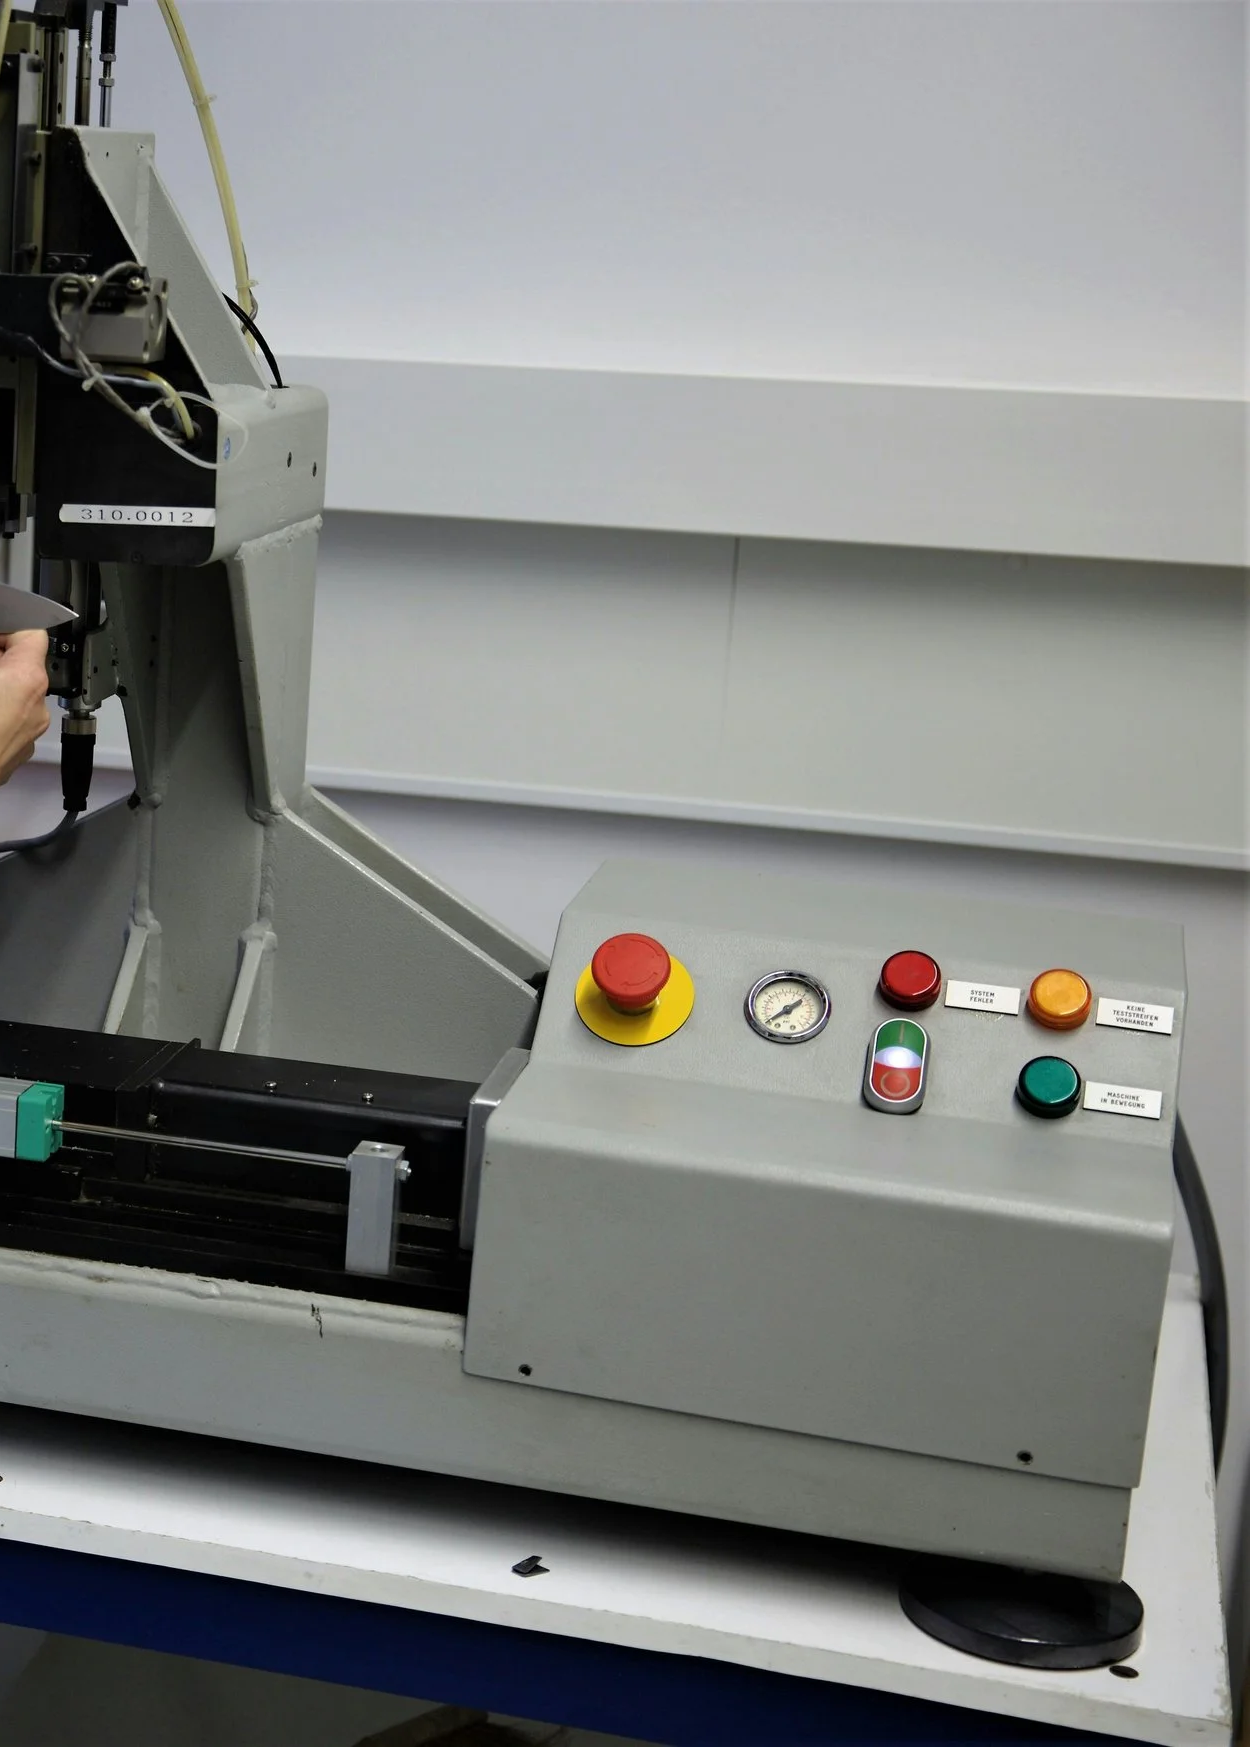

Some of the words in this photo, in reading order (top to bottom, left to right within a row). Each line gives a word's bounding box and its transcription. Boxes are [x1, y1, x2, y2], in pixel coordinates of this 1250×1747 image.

[81, 508, 193, 523] 310.0012
[970, 989, 995, 998] SYSTEM
[1126, 1005, 1146, 1013] KEINE
[1113, 1010, 1159, 1021] TESTSTREIFEN
[1116, 1017, 1154, 1027] VORHANDEN
[1107, 1091, 1140, 1101] MASCHINE
[1110, 1099, 1146, 1109] BEWEGUNG
